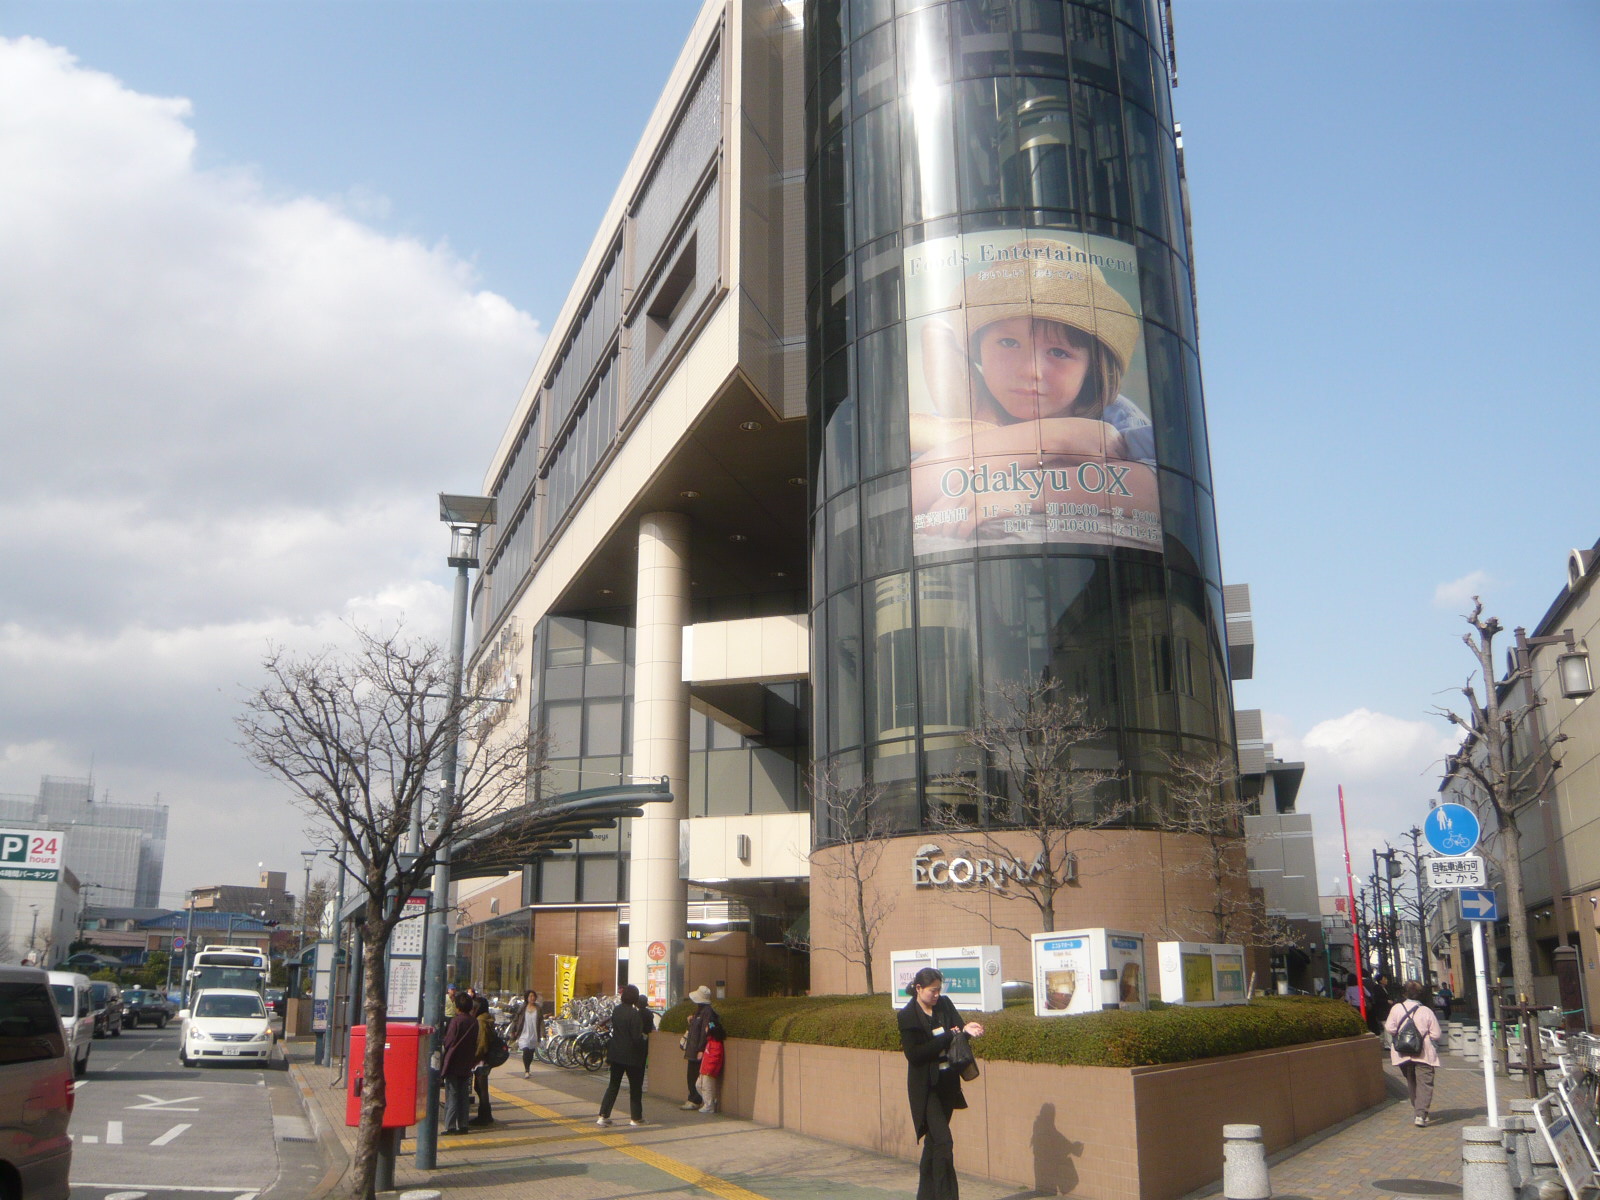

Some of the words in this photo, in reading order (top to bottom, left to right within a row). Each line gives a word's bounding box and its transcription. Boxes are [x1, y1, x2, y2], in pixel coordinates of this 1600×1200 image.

[980, 244, 1136, 275] Entertainment
[941, 461, 1071, 499] Odakyu
[1077, 461, 1133, 497] OX
[2, 836, 23, 860] P
[31, 837, 57, 855] 24
[29, 856, 57, 864] hours
[1431, 860, 1478, 872] 自転車通行可
[1433, 873, 1479, 885] ここから
